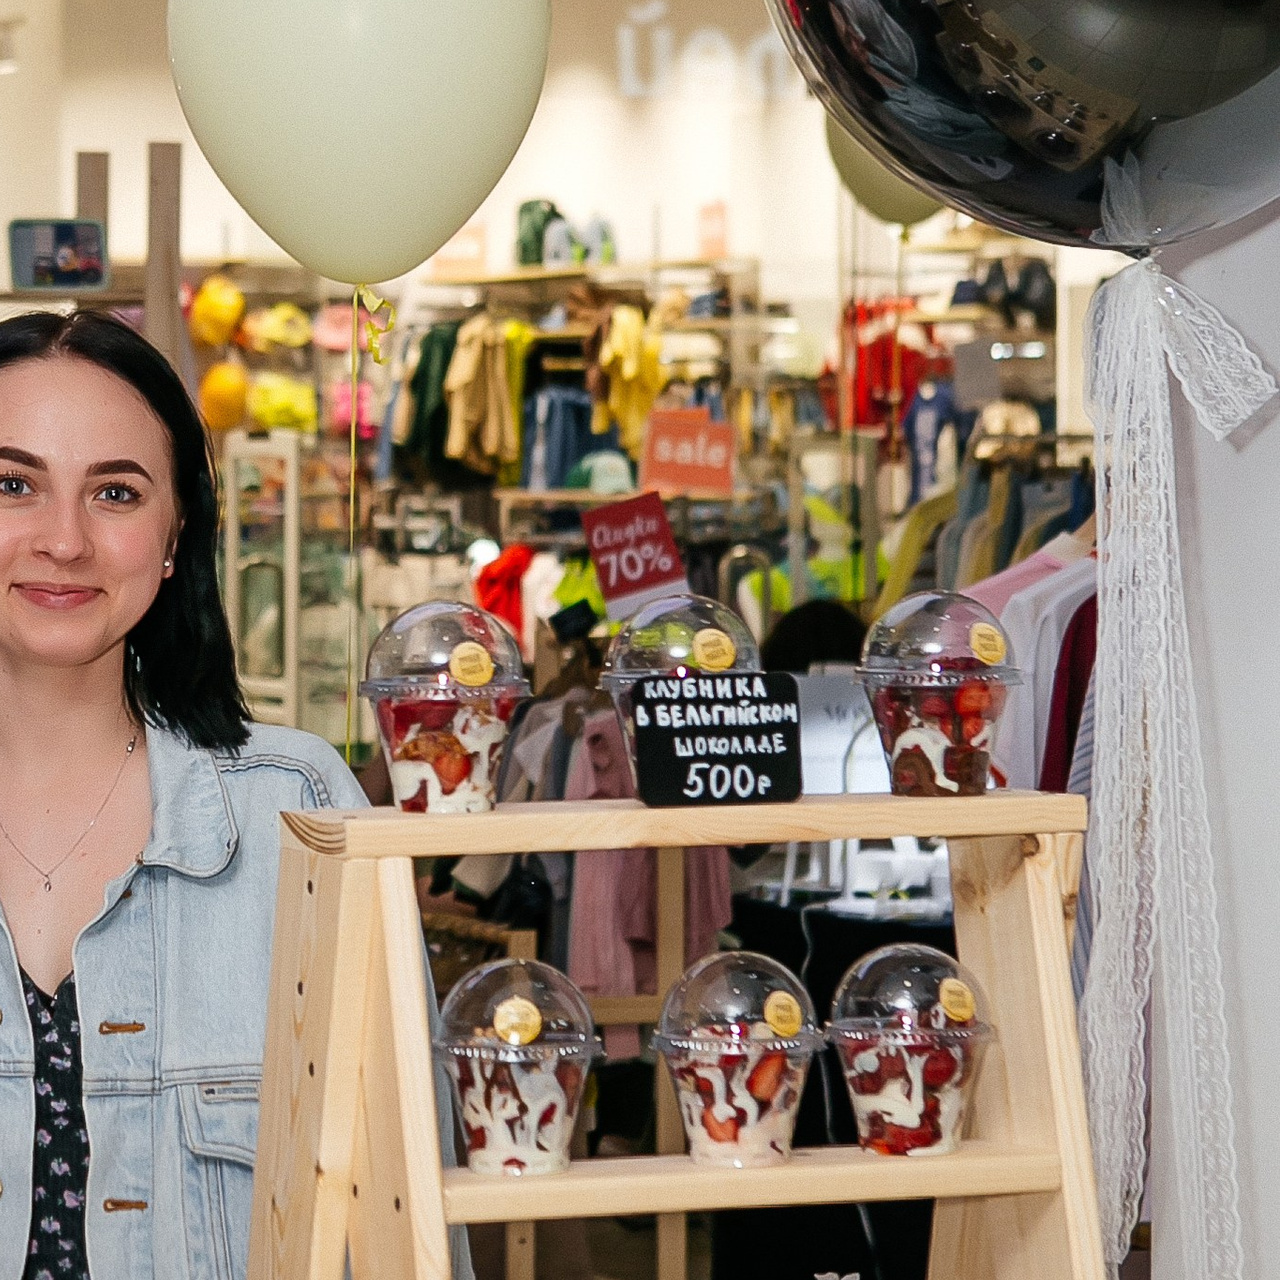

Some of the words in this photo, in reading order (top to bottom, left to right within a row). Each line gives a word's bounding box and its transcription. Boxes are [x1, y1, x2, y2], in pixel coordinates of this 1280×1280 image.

[599, 542, 673, 588] 70%
[643, 676, 768, 700] КЛУБНИКА
[654, 699, 798, 729] БЕЛЬГИЙСКОМ
[674, 732, 788, 758] ШОКОЛАДЕ
